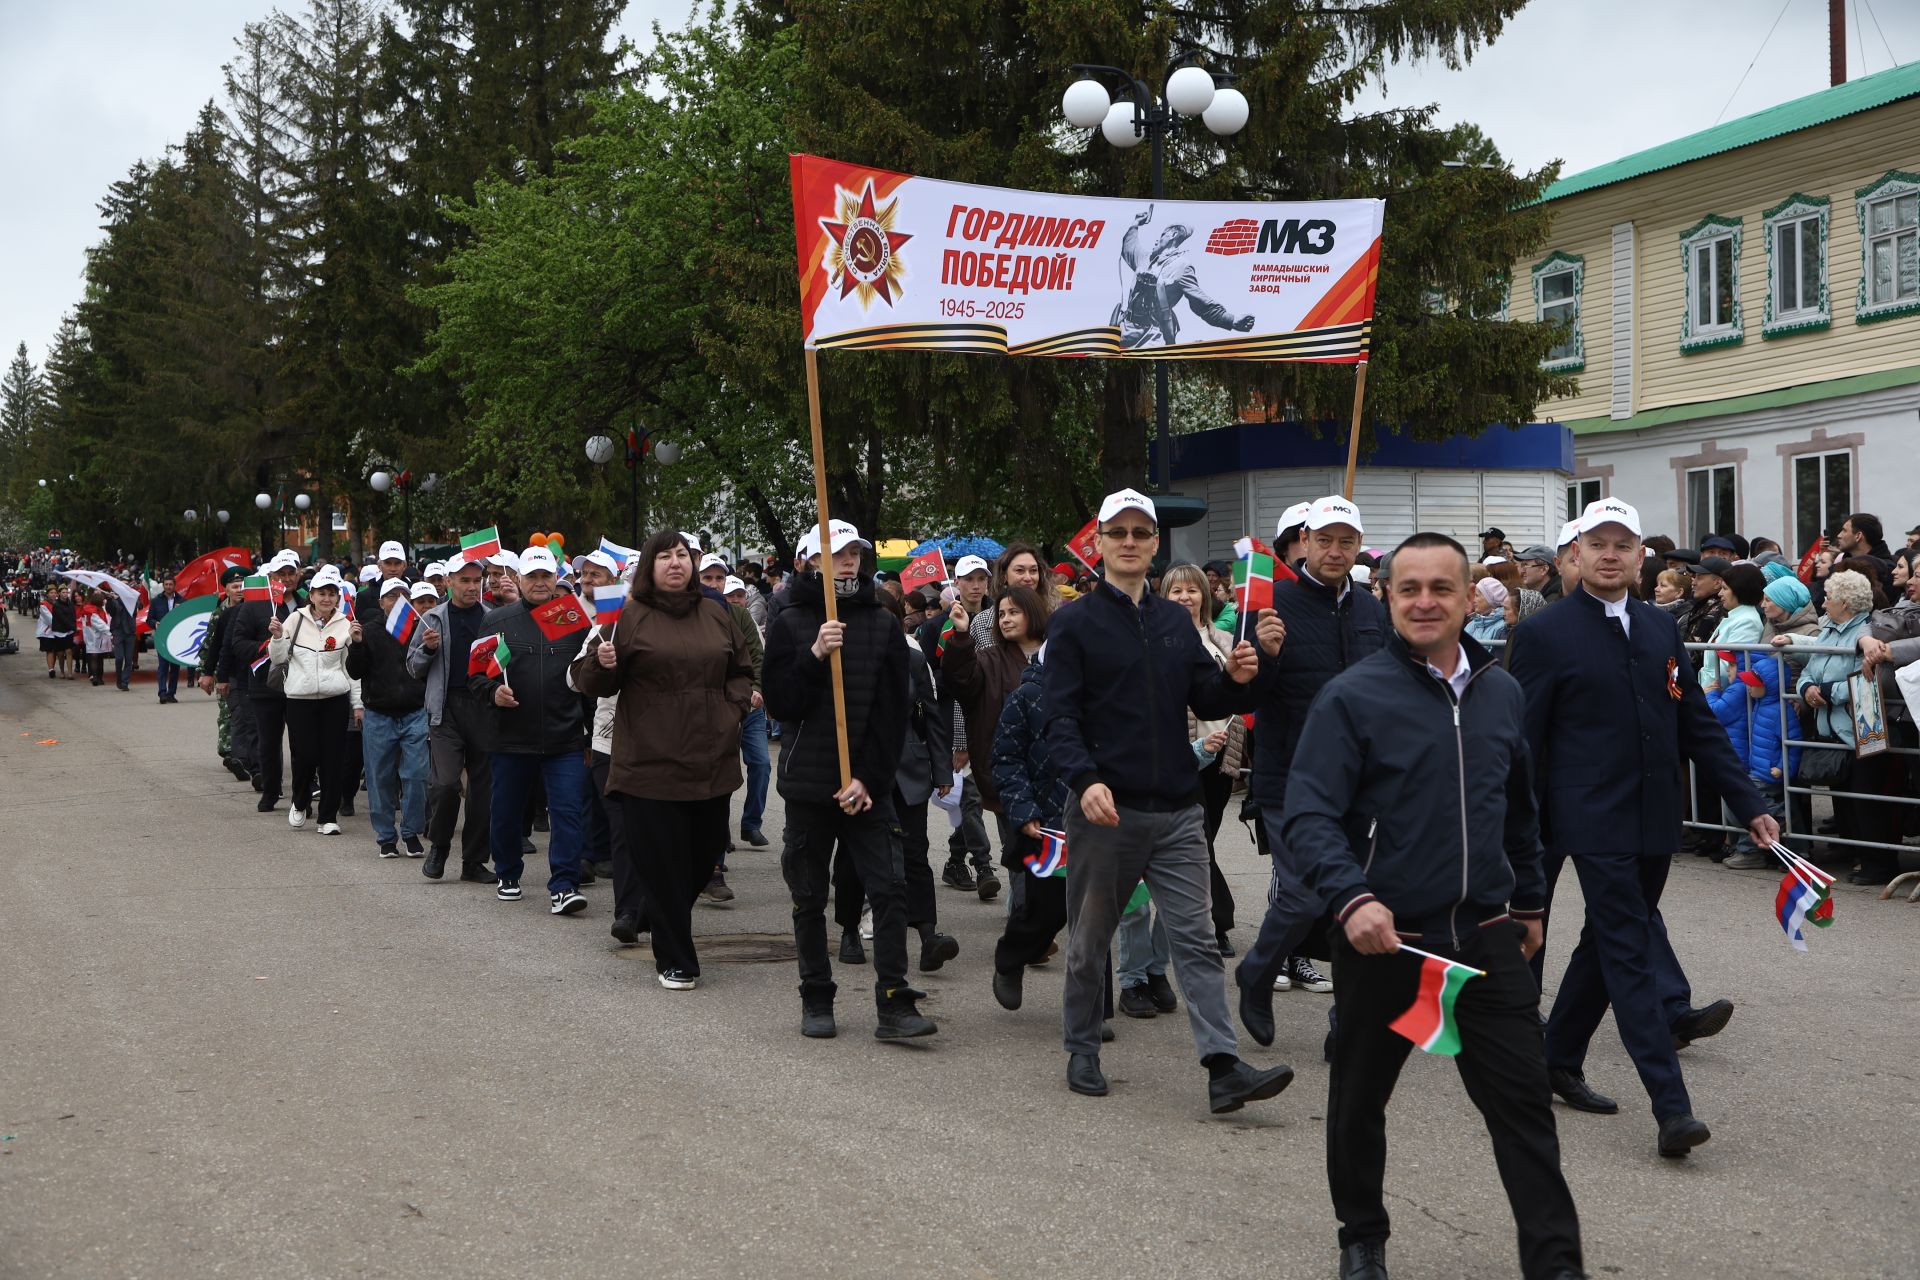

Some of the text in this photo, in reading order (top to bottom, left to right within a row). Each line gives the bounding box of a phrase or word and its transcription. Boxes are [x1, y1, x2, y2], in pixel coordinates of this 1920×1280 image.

[946, 204, 1106, 250] ГОРДИМСЯ
[1256, 219, 1337, 255] МКЗ
[941, 249, 1077, 295] ПОБЕДОЙ!
[1250, 274, 1311, 283] КИРПИЧНЫЙ
[1252, 263, 1330, 273] МАМАДЫШСКИЙ
[1248, 284, 1281, 294] ЗАВОД
